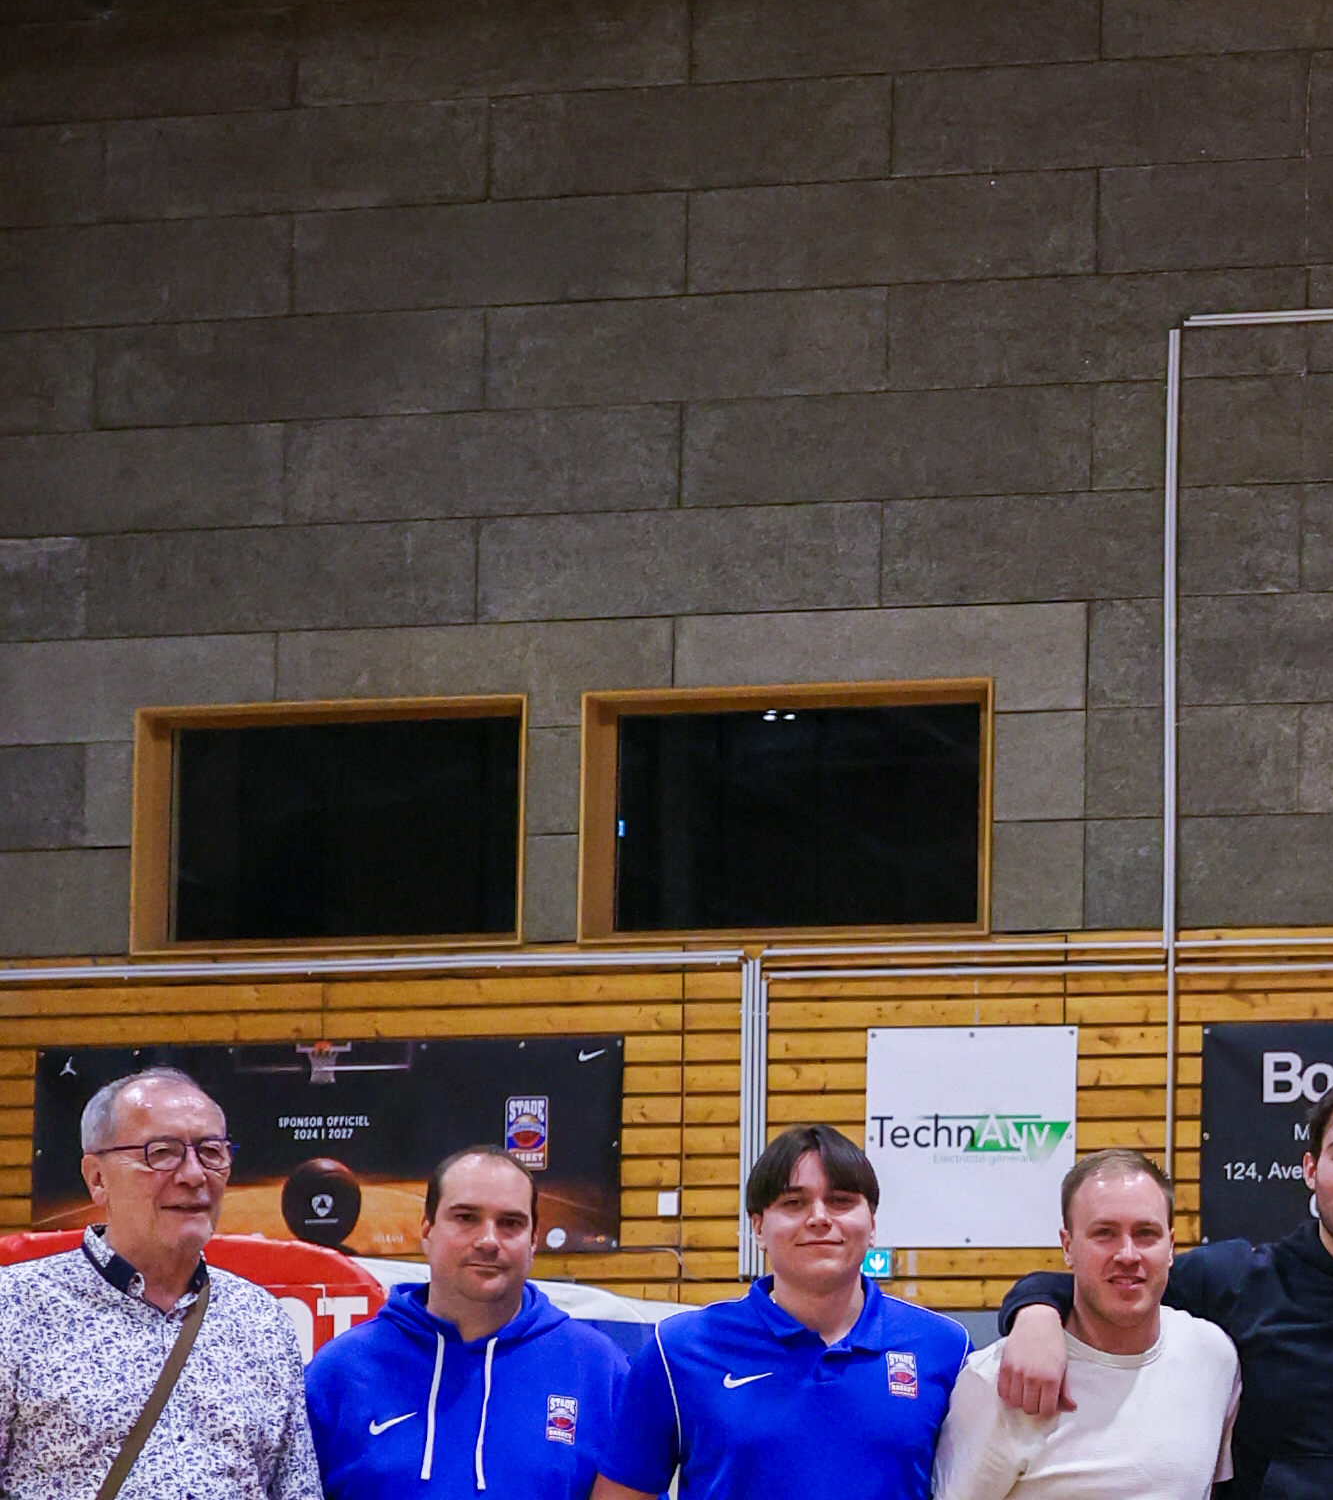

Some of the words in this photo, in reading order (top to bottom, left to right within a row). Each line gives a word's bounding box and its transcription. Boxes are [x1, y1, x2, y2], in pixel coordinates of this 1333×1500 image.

[508, 1100, 545, 1123] STADE
[278, 1115, 323, 1128] SPONSOR
[326, 1115, 371, 1127] OFFICIEL
[293, 1128, 318, 1140] 2024
[1223, 1162, 1264, 1182] 124,
